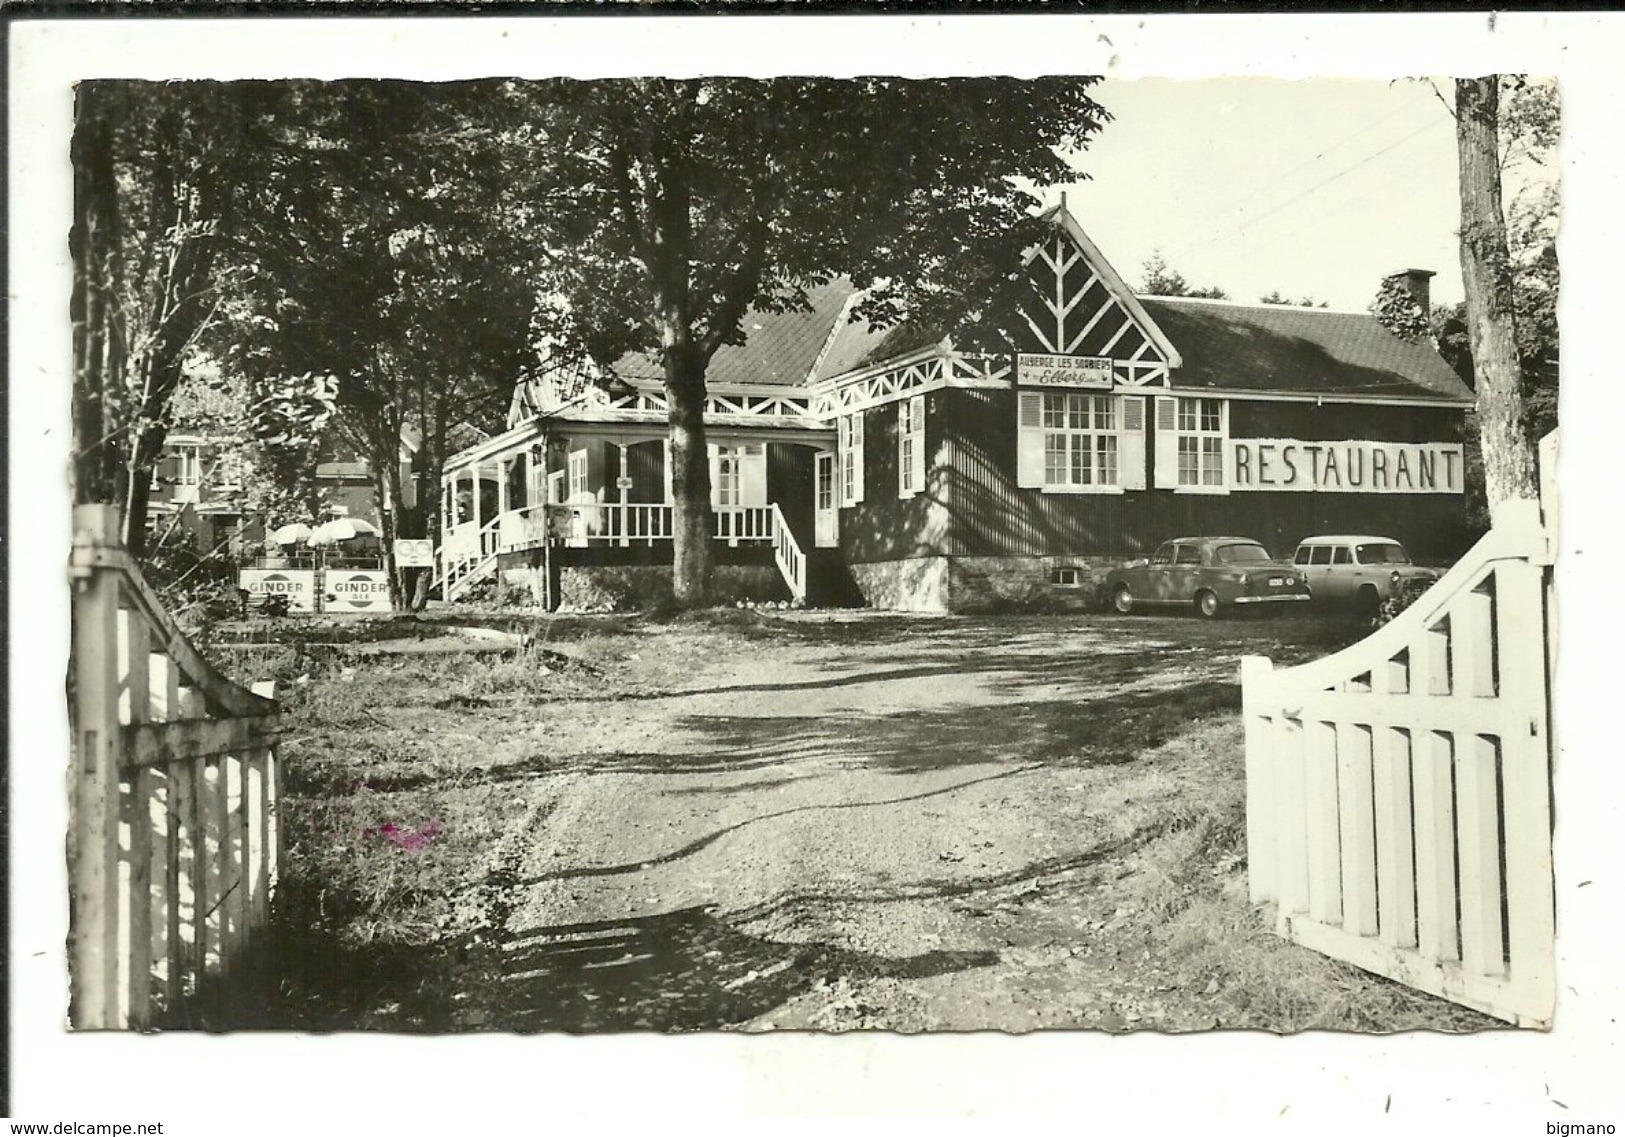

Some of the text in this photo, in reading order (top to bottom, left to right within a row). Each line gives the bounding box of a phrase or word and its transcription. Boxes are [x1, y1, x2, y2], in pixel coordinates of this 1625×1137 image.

[1019, 356, 1055, 368] AUBERGE
[1057, 358, 1073, 368] LES
[1235, 444, 1459, 489] RESTAURANT
[250, 582, 304, 593] GINDER
[334, 582, 386, 593] GINDER
